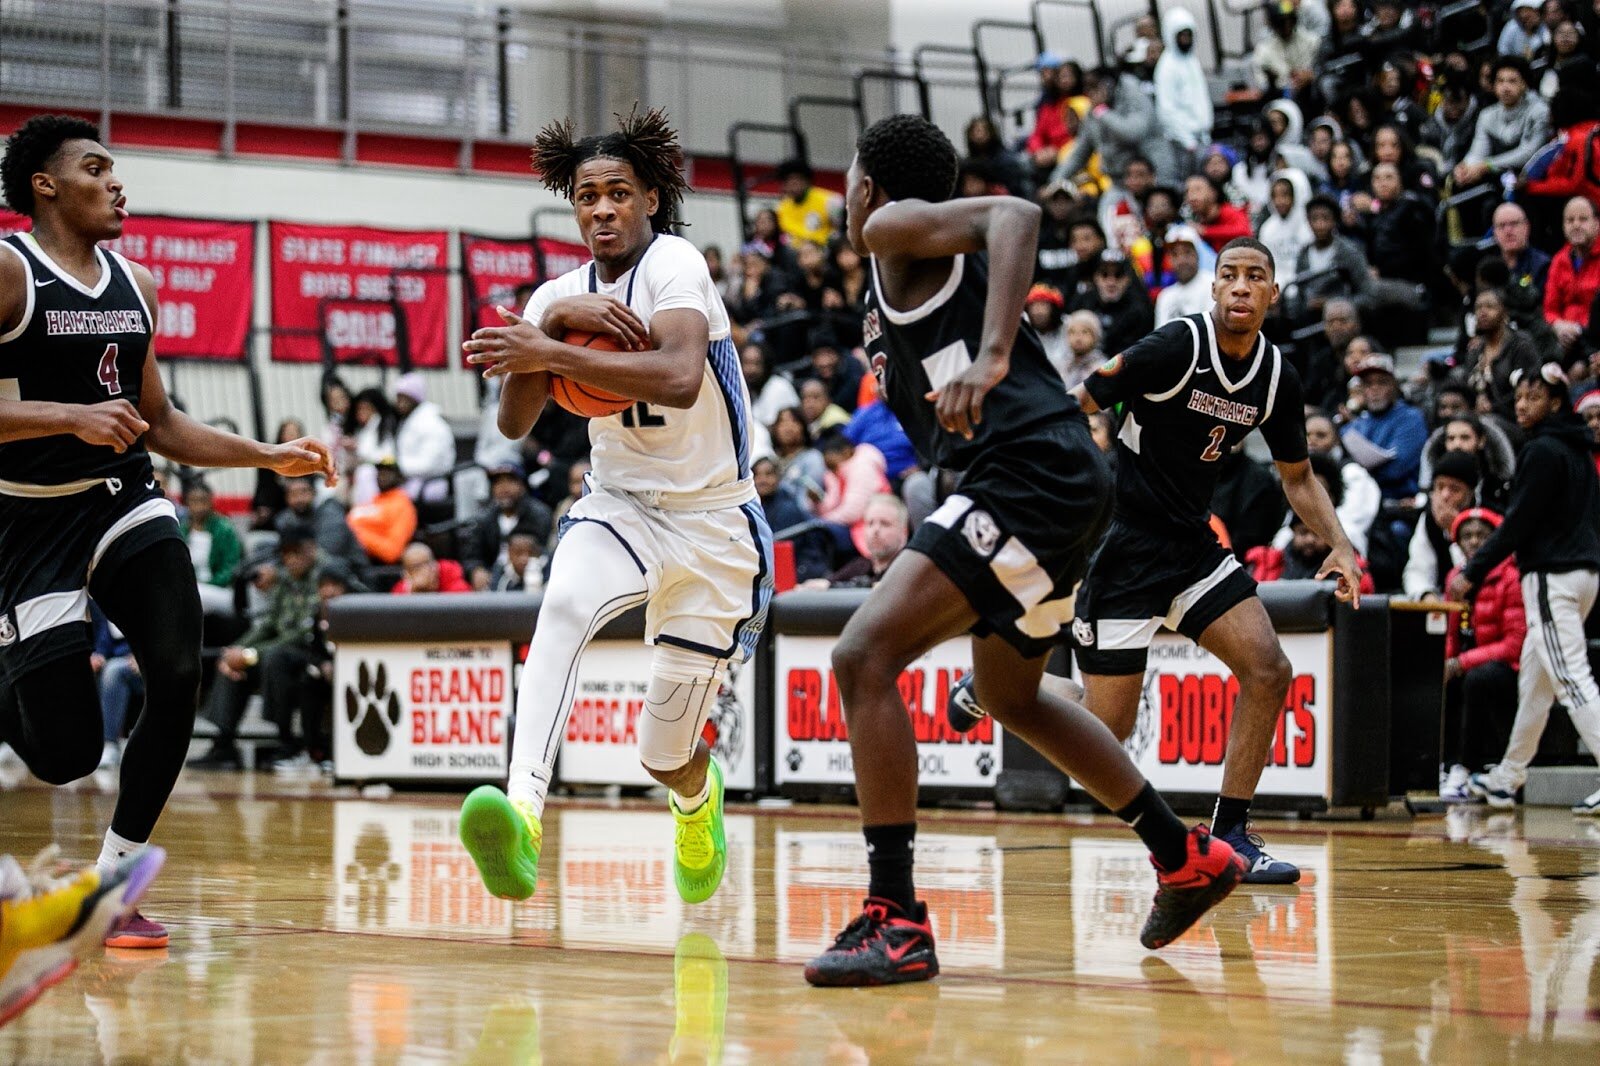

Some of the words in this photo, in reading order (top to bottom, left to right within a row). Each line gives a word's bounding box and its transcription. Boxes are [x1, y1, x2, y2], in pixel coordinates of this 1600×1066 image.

[280, 236, 345, 265] STATE
[351, 239, 438, 270] FINALIST
[45, 310, 146, 335] HAMTRAMCK
[97, 343, 122, 395] 4
[1186, 388, 1258, 426] HAMTRAMCK
[1200, 425, 1226, 461] 2
[1151, 645, 1189, 660] HOME
[411, 668, 504, 703] GRAND
[411, 709, 503, 745] BLANC
[566, 698, 644, 744] BOBCA
[412, 754, 445, 768] HIGH
[448, 754, 501, 768] SCHOOL
